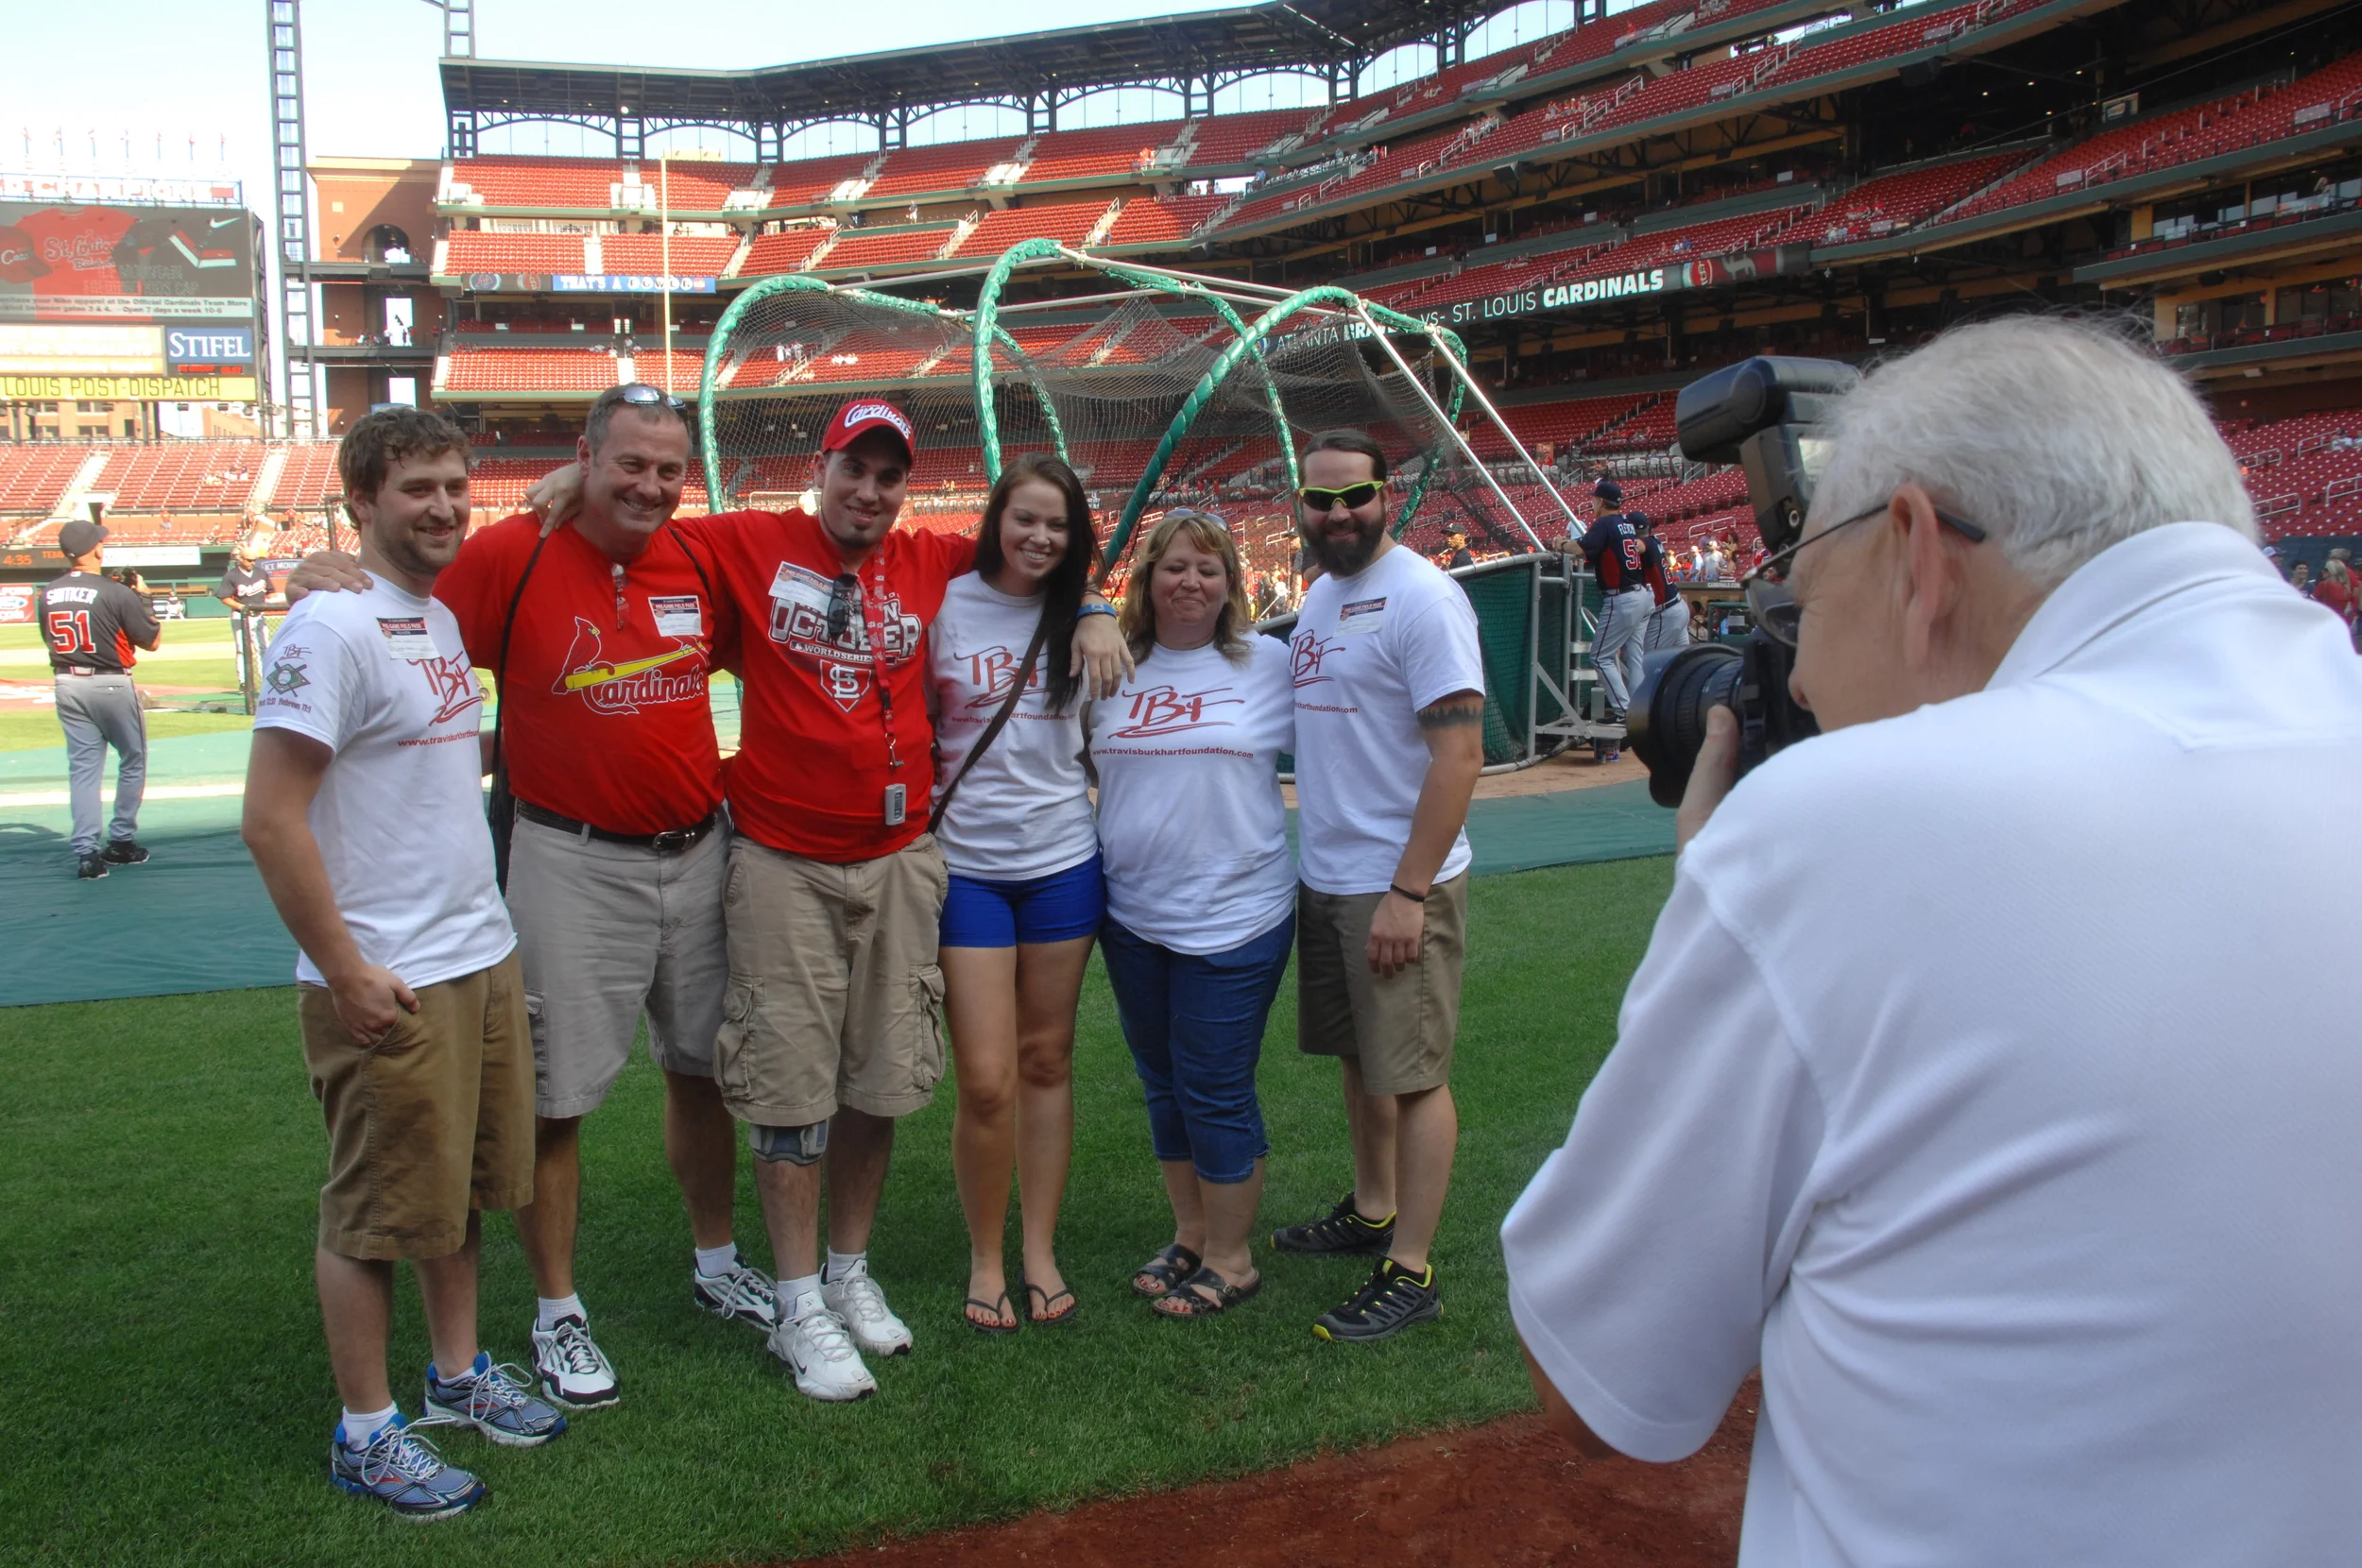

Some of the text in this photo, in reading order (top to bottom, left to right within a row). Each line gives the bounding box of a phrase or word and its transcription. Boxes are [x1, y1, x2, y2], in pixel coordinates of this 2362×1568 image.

[1452, 302, 1476, 323] ST.
[1484, 292, 1536, 316] LOUIS
[1543, 269, 1664, 308] CARDINALS
[169, 332, 250, 357] STIFEL
[4, 378, 220, 397] LOUIS POST-DISPATCH
[844, 404, 912, 440] Cardinals
[1617, 523, 1636, 536] FLETCH
[3, 551, 65, 565] 4:35 TEM
[48, 609, 97, 655] 51
[581, 664, 704, 715] Cardinals
[1093, 747, 1254, 758] www.travisburkhartfoundation.com
